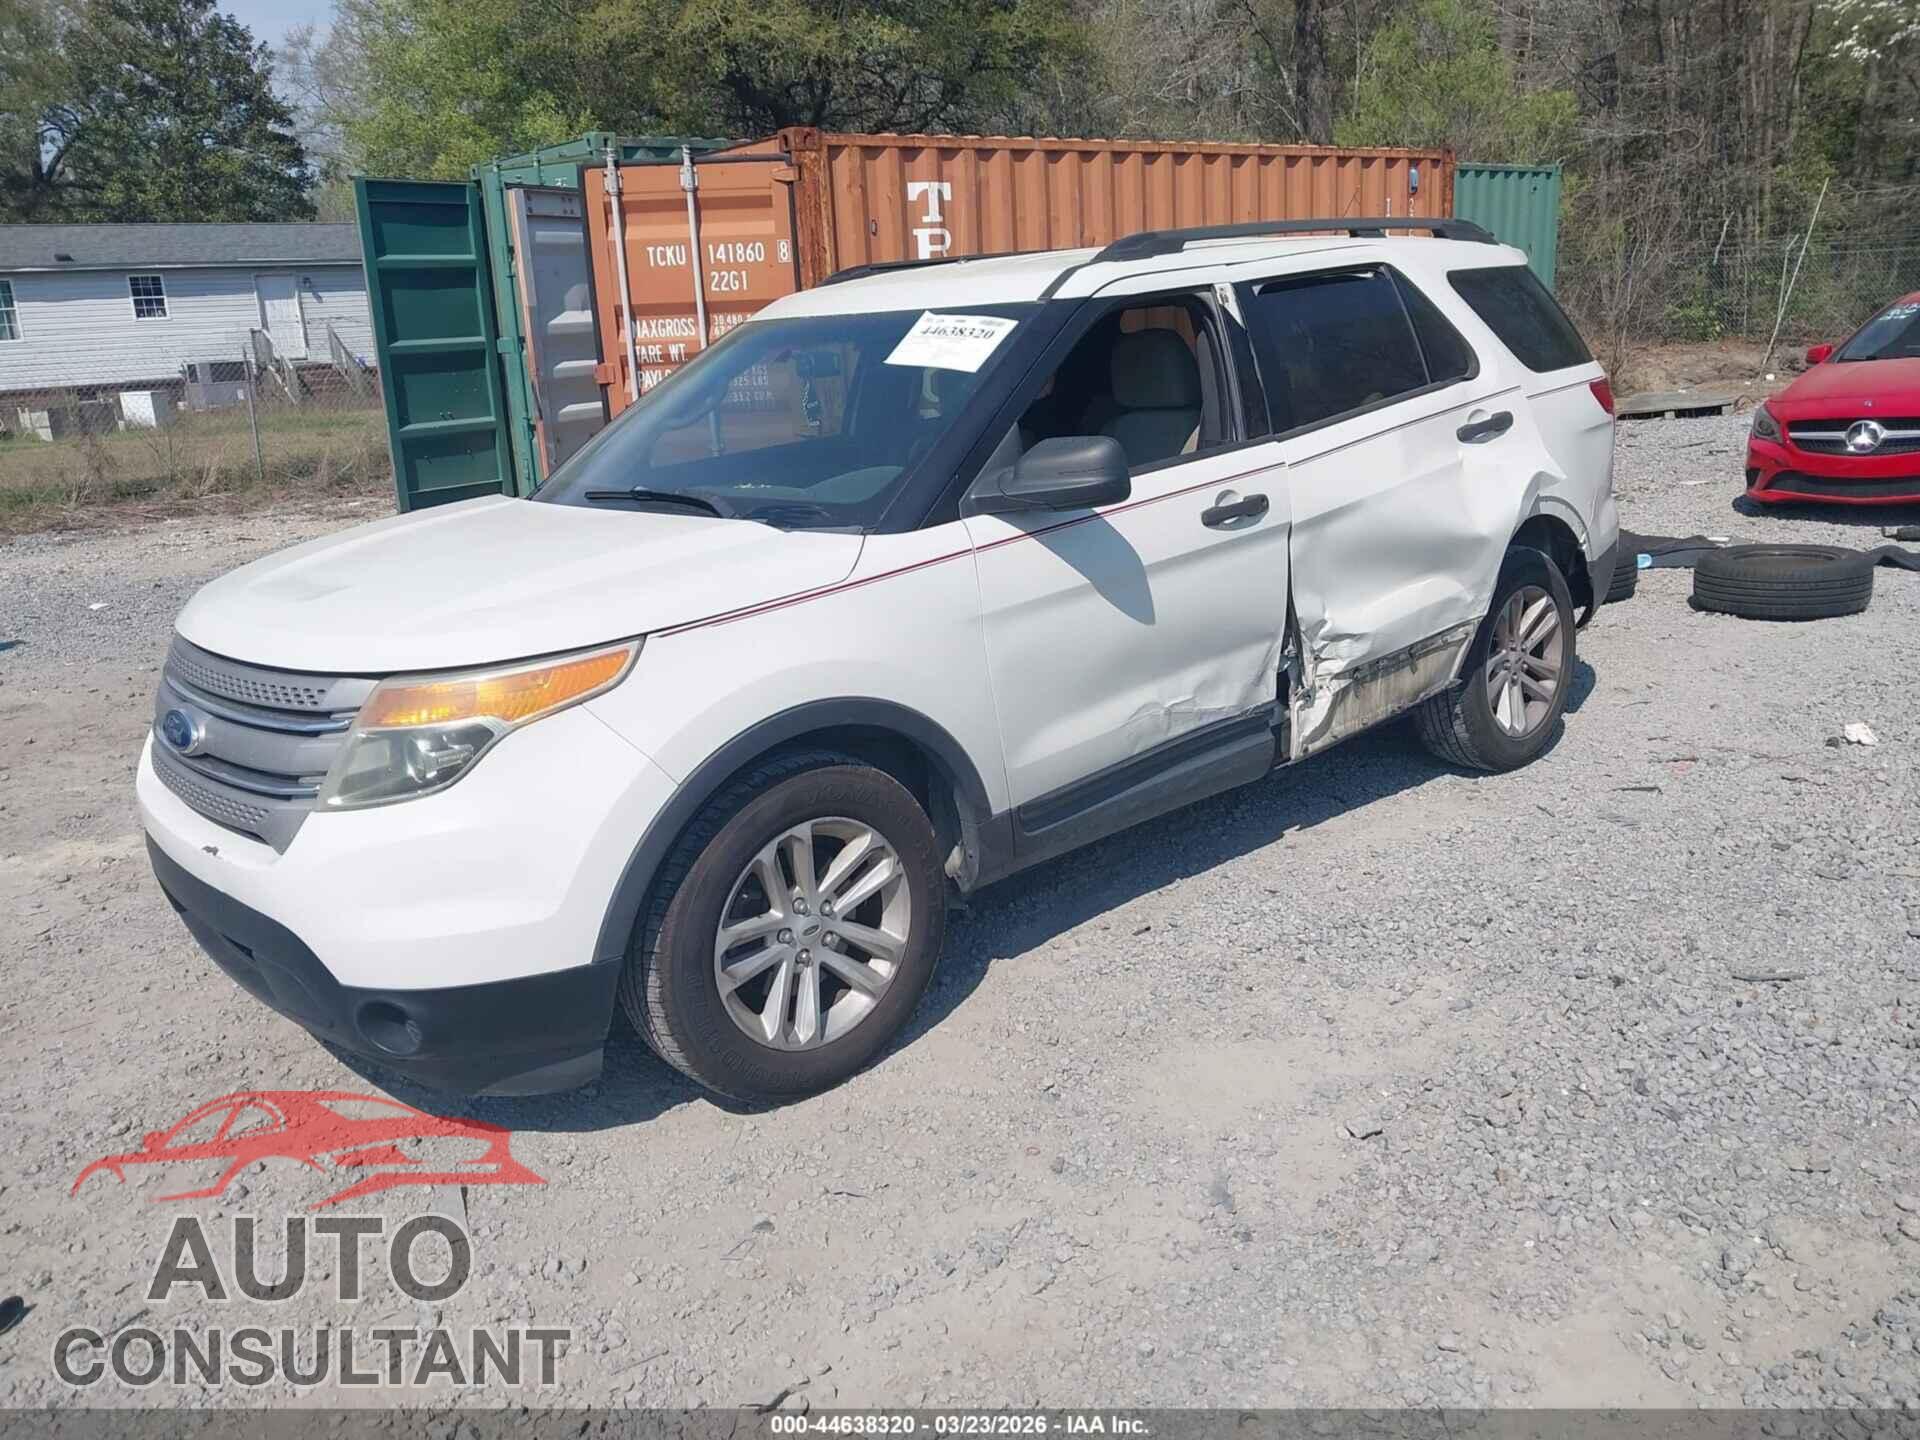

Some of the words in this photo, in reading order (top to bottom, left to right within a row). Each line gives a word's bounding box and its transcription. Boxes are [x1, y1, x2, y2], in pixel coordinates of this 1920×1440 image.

[646, 244, 687, 267] TCKU
[707, 241, 765, 265] 141860
[779, 241, 789, 261] 8
[710, 270, 749, 292] 22G1
[921, 325, 996, 340] 44638320
[635, 344, 665, 364] TARE
